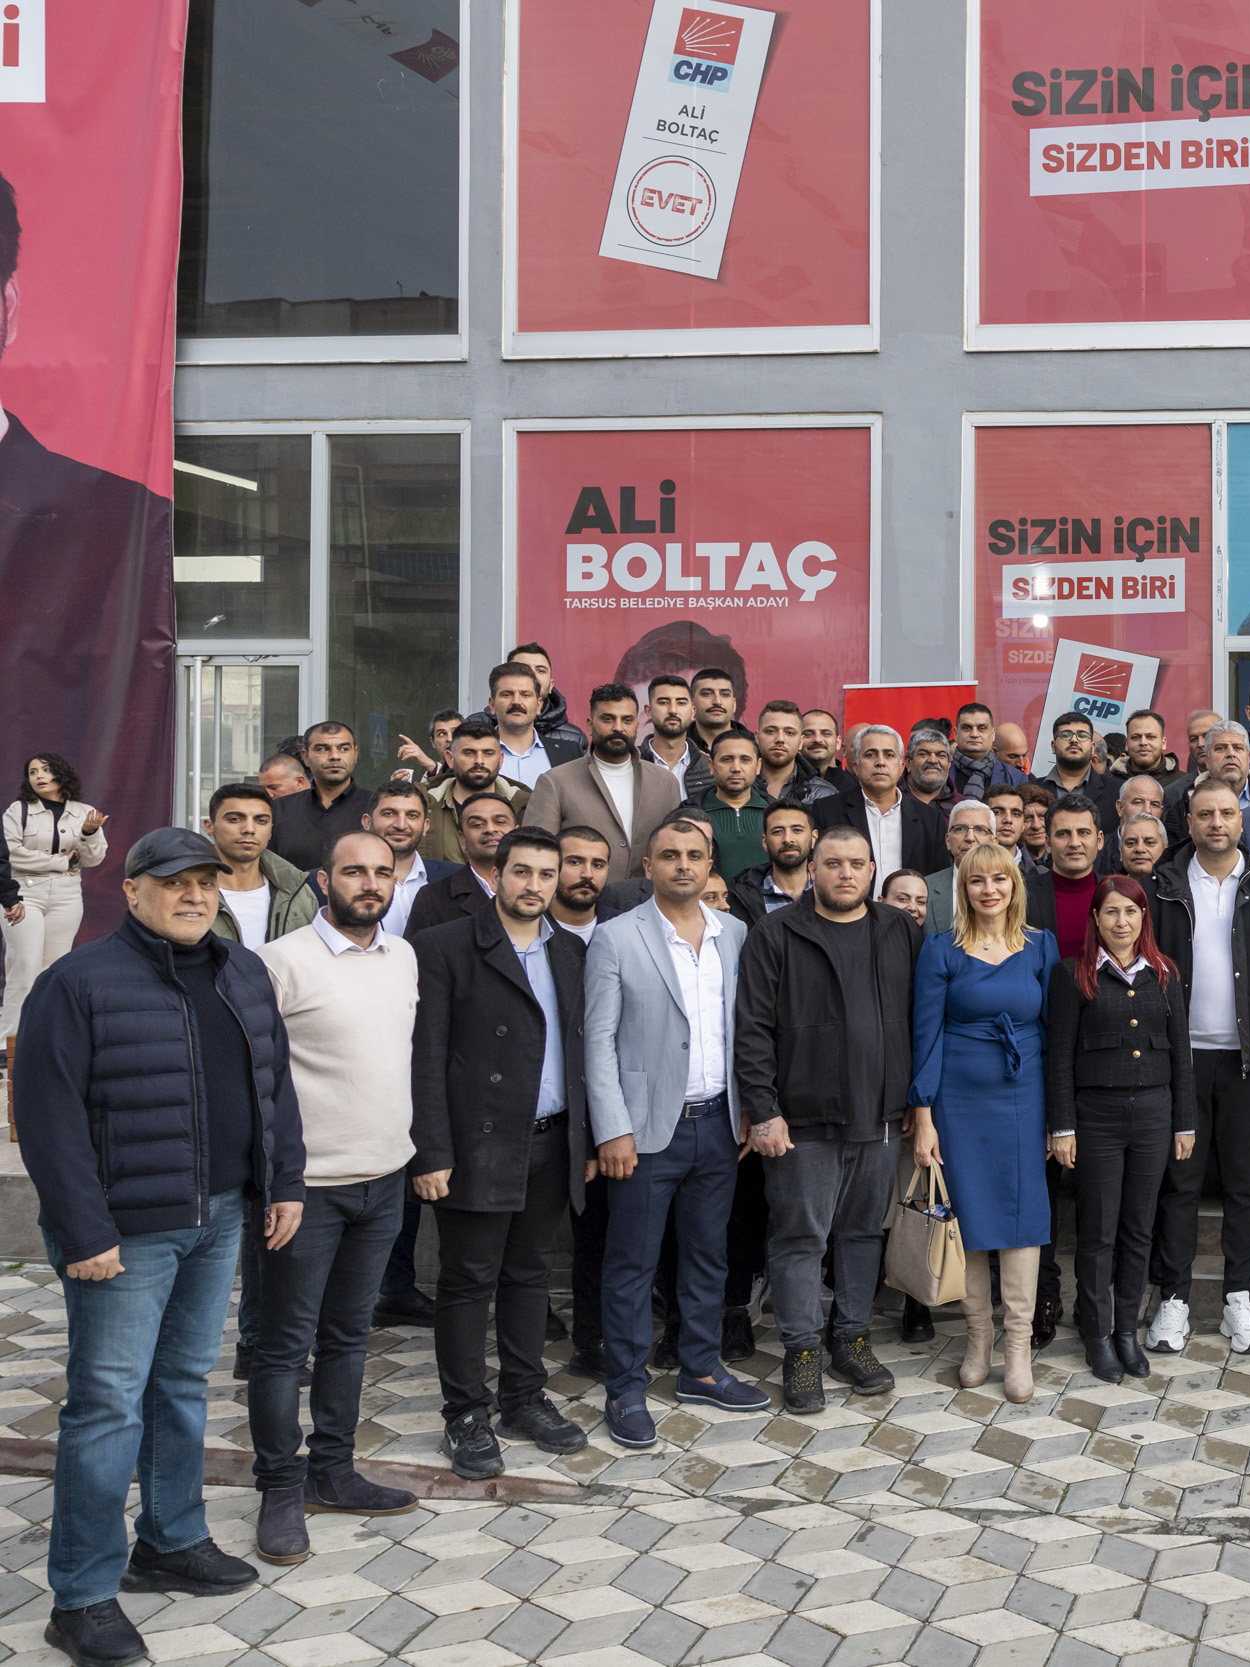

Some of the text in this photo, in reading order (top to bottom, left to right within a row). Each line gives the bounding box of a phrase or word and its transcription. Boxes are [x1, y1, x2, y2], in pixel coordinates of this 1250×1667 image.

[673, 60, 728, 86] CHP
[678, 104, 706, 120] ALİ
[656, 119, 719, 144] BOLTAÇ
[640, 187, 703, 216] EVET
[566, 541, 838, 601] BOLTAÇ
[564, 598, 616, 609] TARSUS
[688, 597, 744, 611] BAŞKAN
[747, 597, 788, 607] ADAYI
[1073, 696, 1121, 719] CHP
